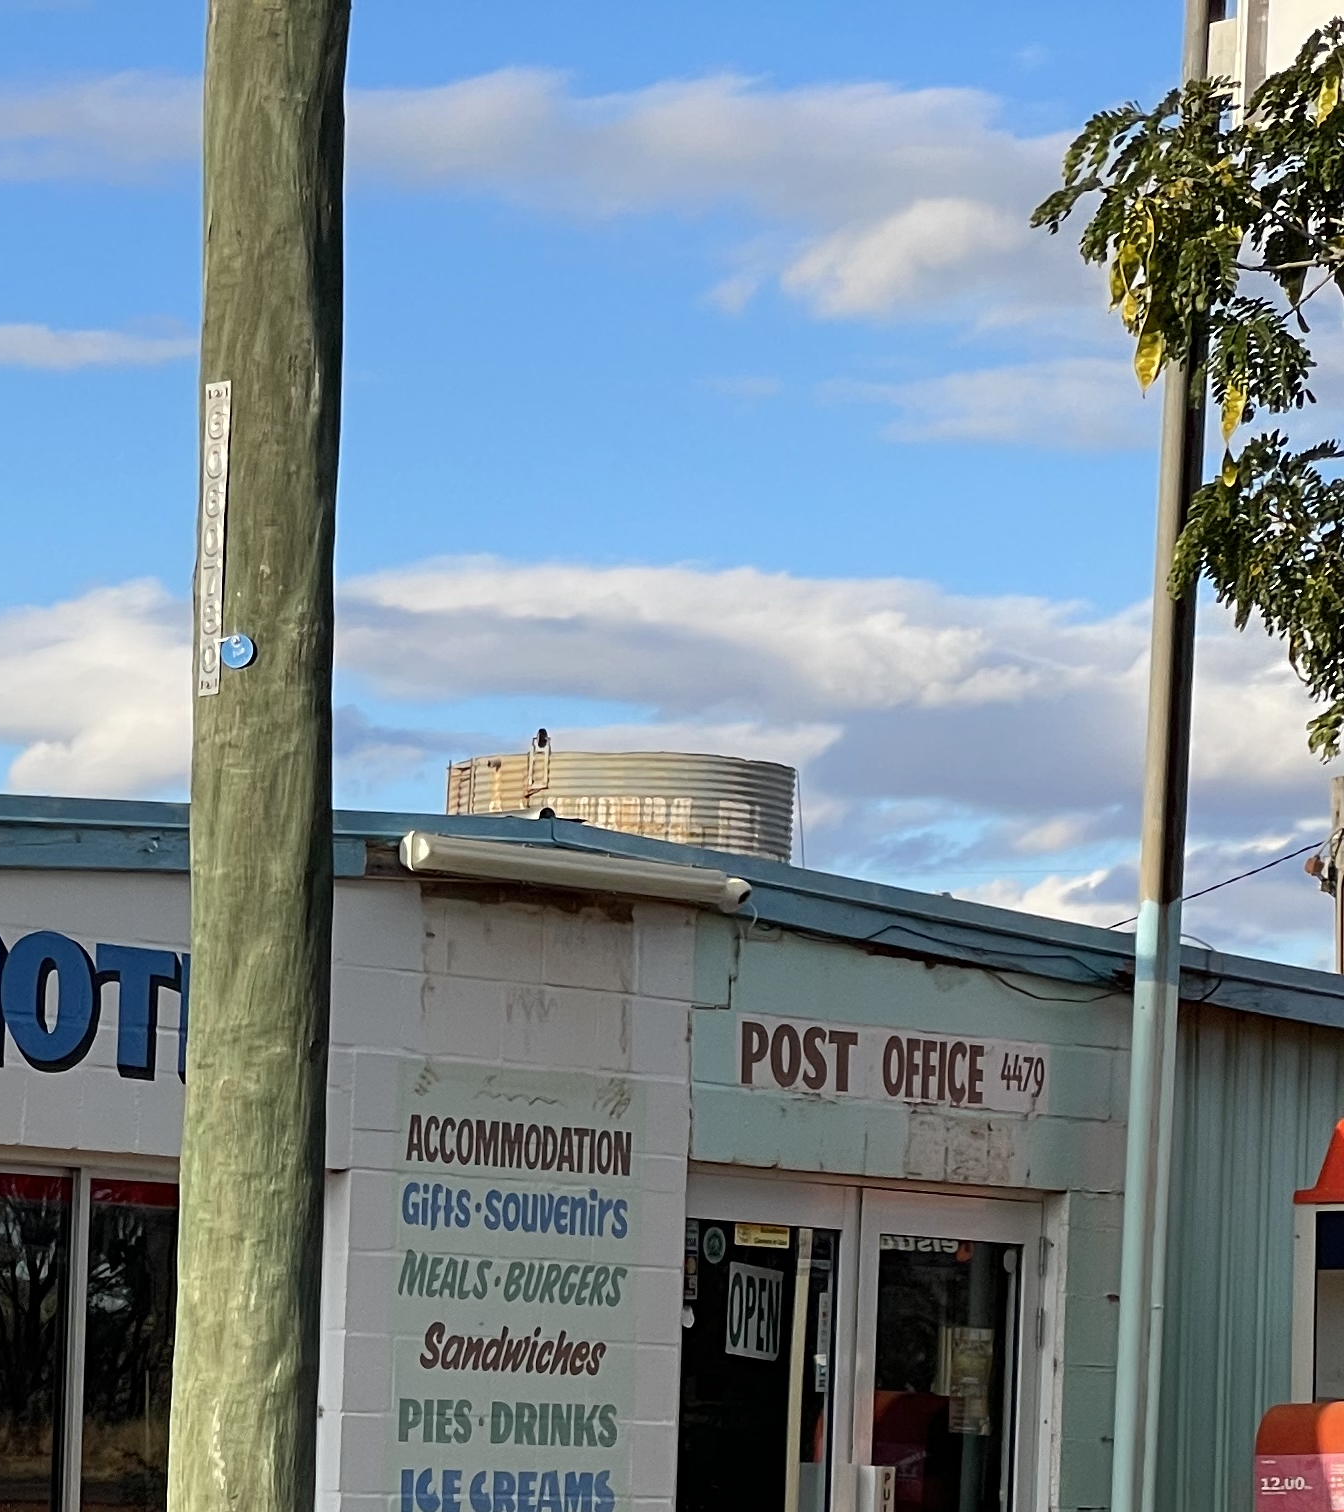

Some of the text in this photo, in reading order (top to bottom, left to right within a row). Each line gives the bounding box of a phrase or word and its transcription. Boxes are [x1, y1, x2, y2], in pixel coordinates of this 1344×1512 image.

[741, 1021, 1044, 1104] POST OFFICE 4479
[406, 1115, 632, 1176] ACCOMMODATION
[398, 1249, 493, 1300] MEALS
[503, 1261, 628, 1307] BURGERS
[728, 1271, 781, 1355] OPEN
[420, 1321, 606, 1376] Sandwiches
[398, 1398, 617, 1447] PIES DRINKS
